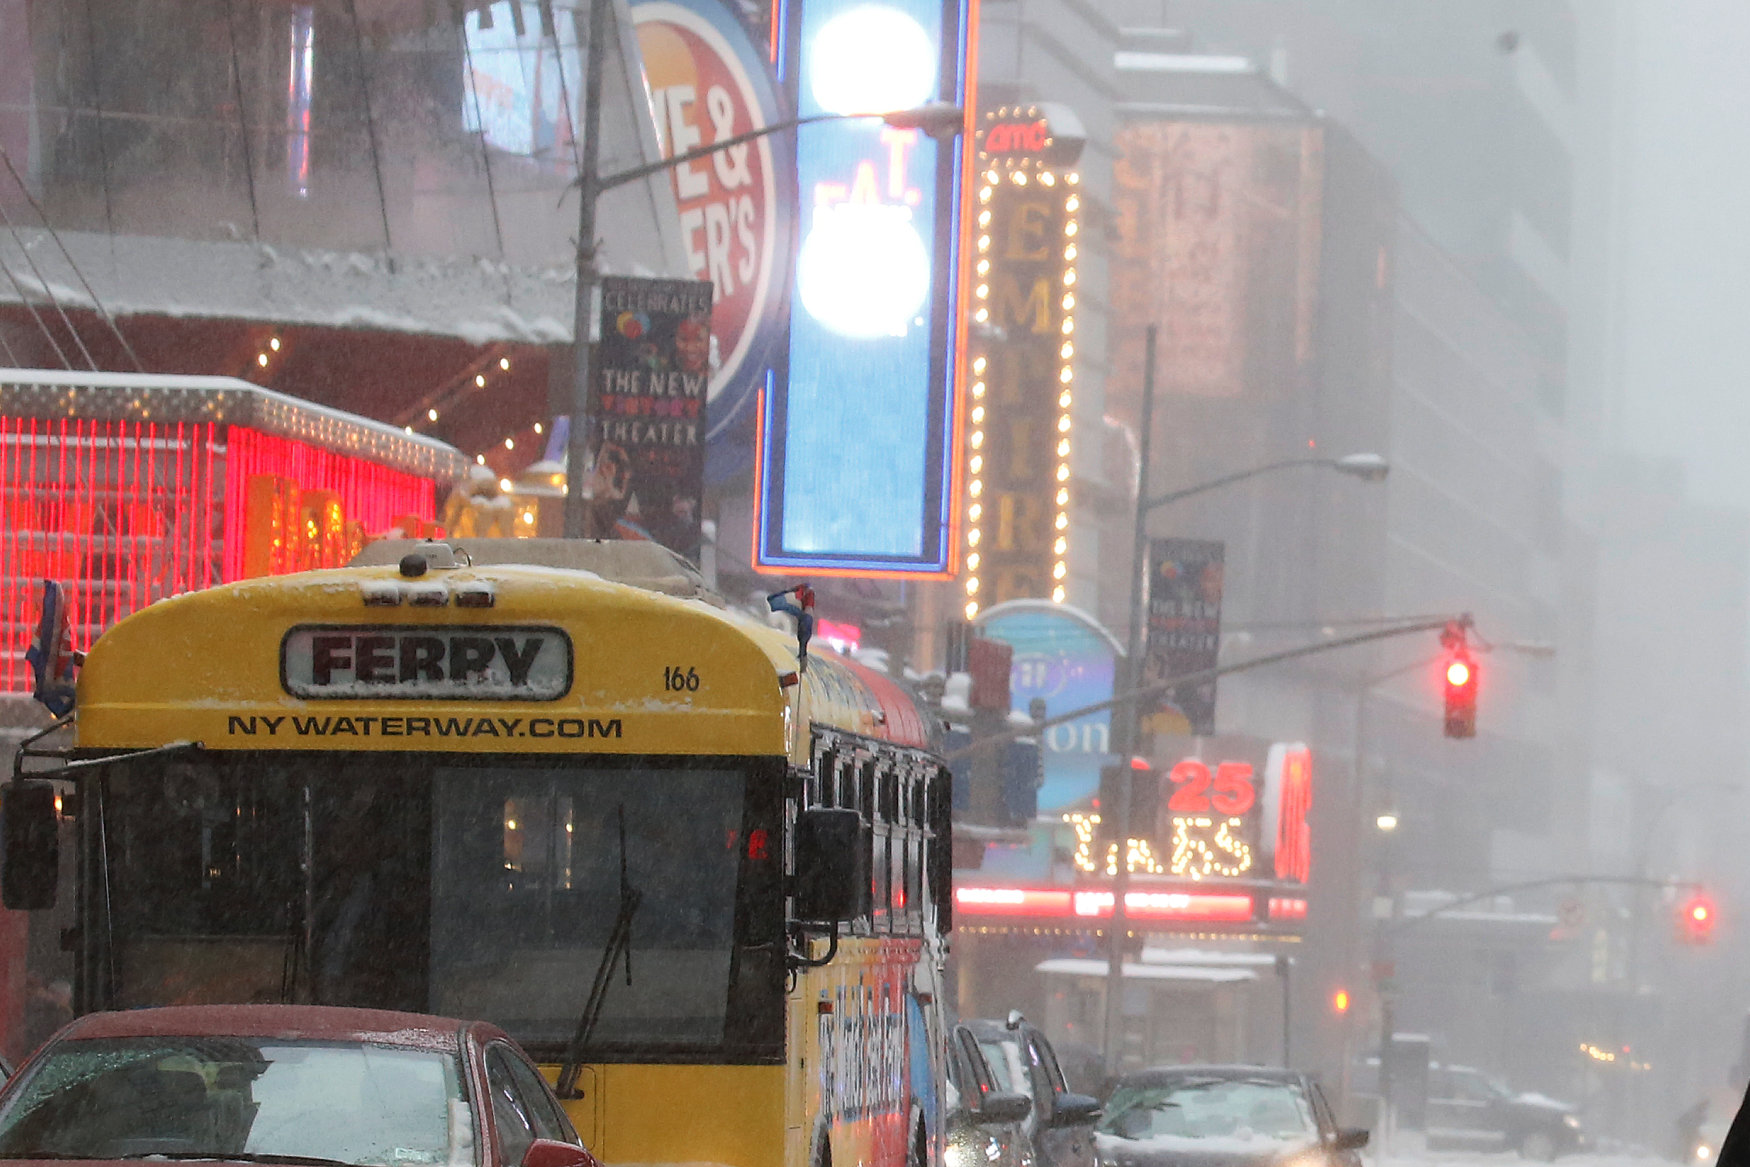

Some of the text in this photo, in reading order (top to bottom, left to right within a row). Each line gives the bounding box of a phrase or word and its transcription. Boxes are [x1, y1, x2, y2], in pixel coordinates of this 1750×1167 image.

[985, 120, 1049, 153] amc
[602, 368, 705, 396] THE NEW
[602, 421, 698, 445] THEATER
[311, 636, 545, 687] FERRY
[663, 665, 701, 692] 166
[228, 715, 624, 738] NY WATERWAY.COM
[1167, 760, 1256, 815] 25
